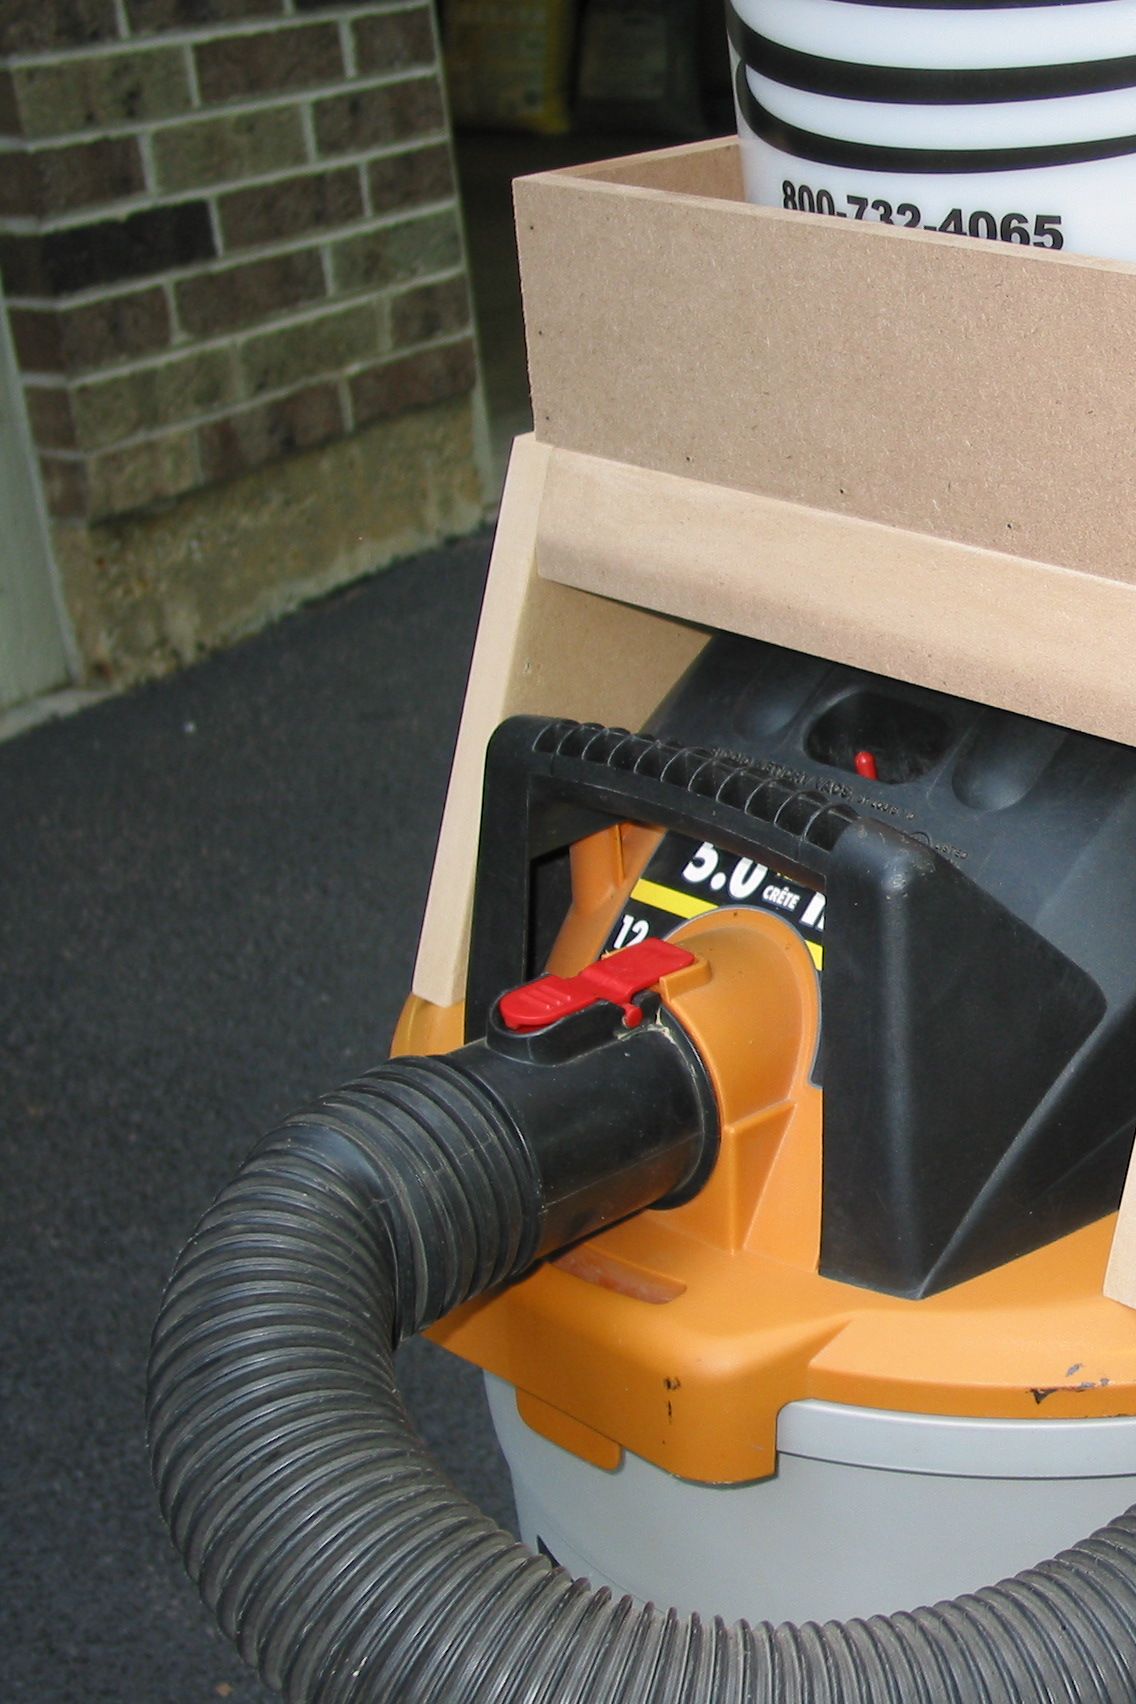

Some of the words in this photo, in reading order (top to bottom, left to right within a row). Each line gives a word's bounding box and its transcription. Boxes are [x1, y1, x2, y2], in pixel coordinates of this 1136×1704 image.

[782, 180, 1064, 250] 800-732-4065
[682, 841, 768, 899] 5.0
[762, 884, 801, 910] CRÊTE
[613, 914, 650, 949] 12
